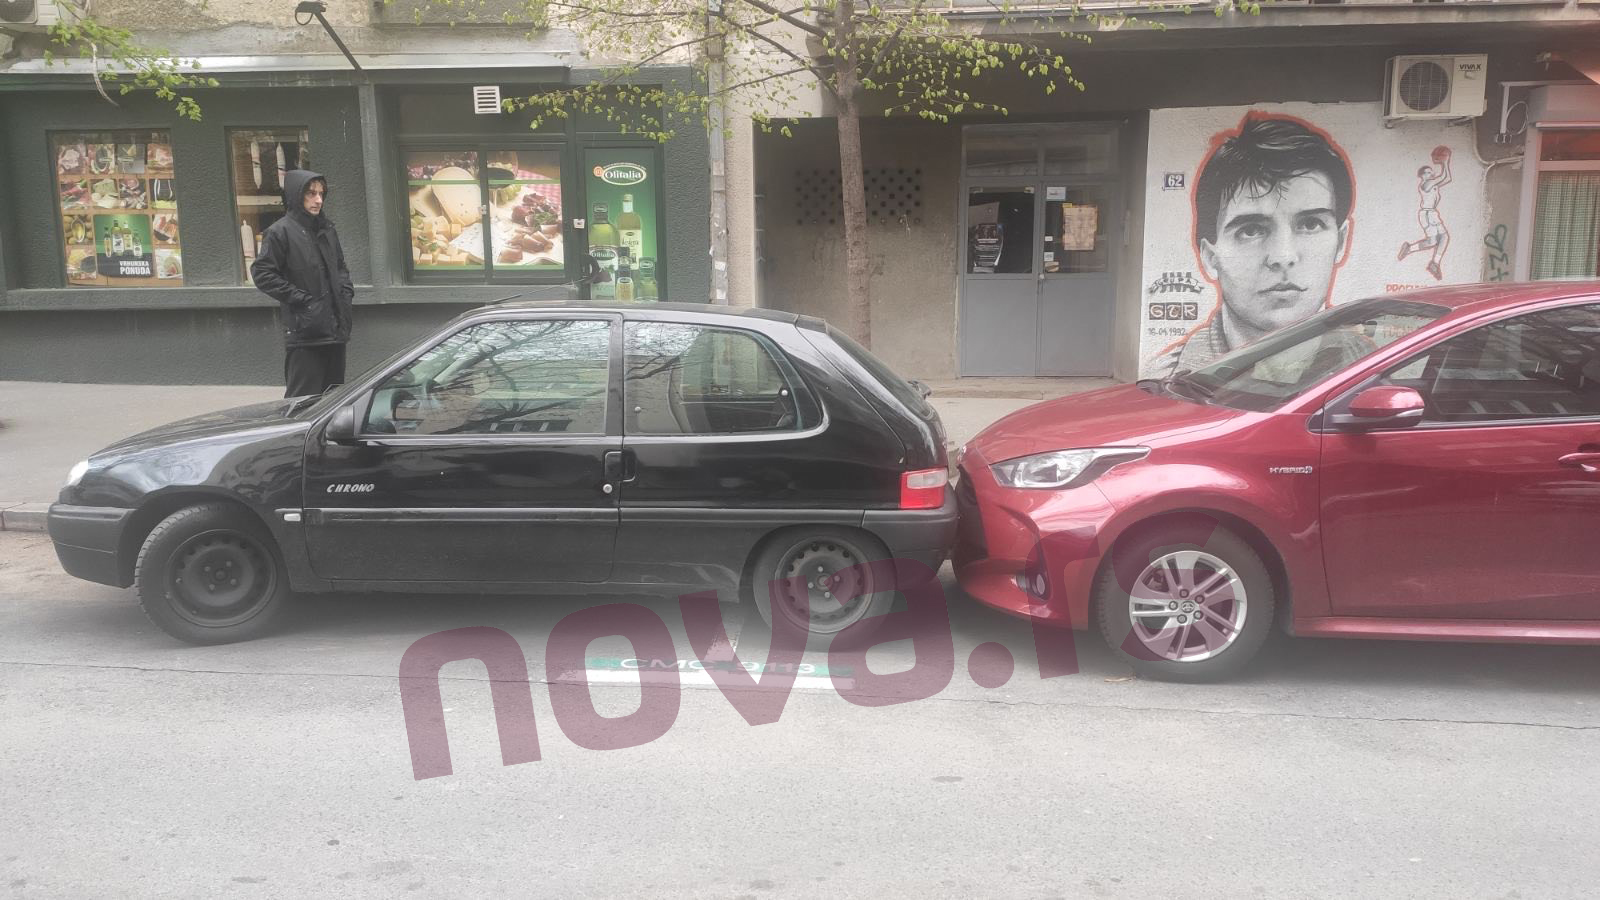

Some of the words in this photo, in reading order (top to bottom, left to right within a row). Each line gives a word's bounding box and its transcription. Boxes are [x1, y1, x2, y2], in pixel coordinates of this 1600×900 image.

[605, 170, 642, 179] Olitalia
[1168, 174, 1183, 187] 62
[120, 267, 151, 275] PONUDA
[1269, 466, 1305, 474] HYBRID
[326, 483, 375, 493] CHRONO
[740, 660, 817, 674] 9113
